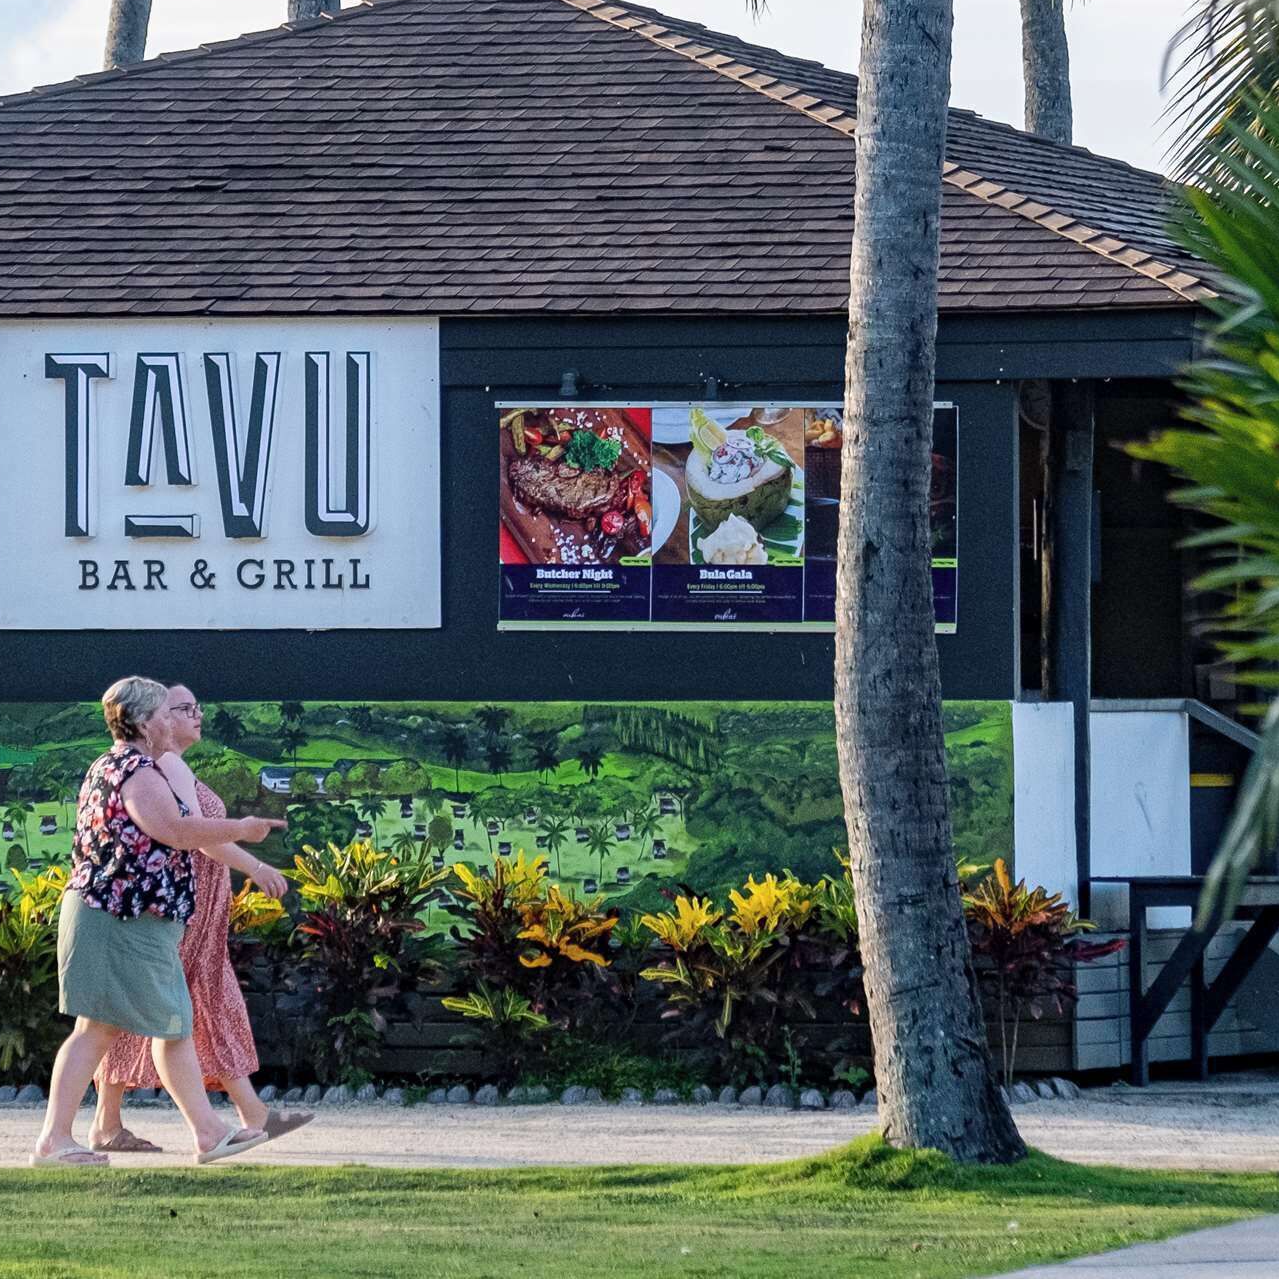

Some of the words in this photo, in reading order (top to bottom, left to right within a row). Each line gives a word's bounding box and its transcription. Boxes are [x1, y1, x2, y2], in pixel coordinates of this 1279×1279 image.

[44, 351, 376, 538] TAVU
[78, 559, 168, 590] BAR
[190, 559, 216, 589] &
[236, 559, 371, 590] GRILL
[536, 568, 581, 579] Butcher
[582, 568, 613, 581] Night
[699, 569, 726, 580] Bula
[727, 569, 752, 580] Gala
